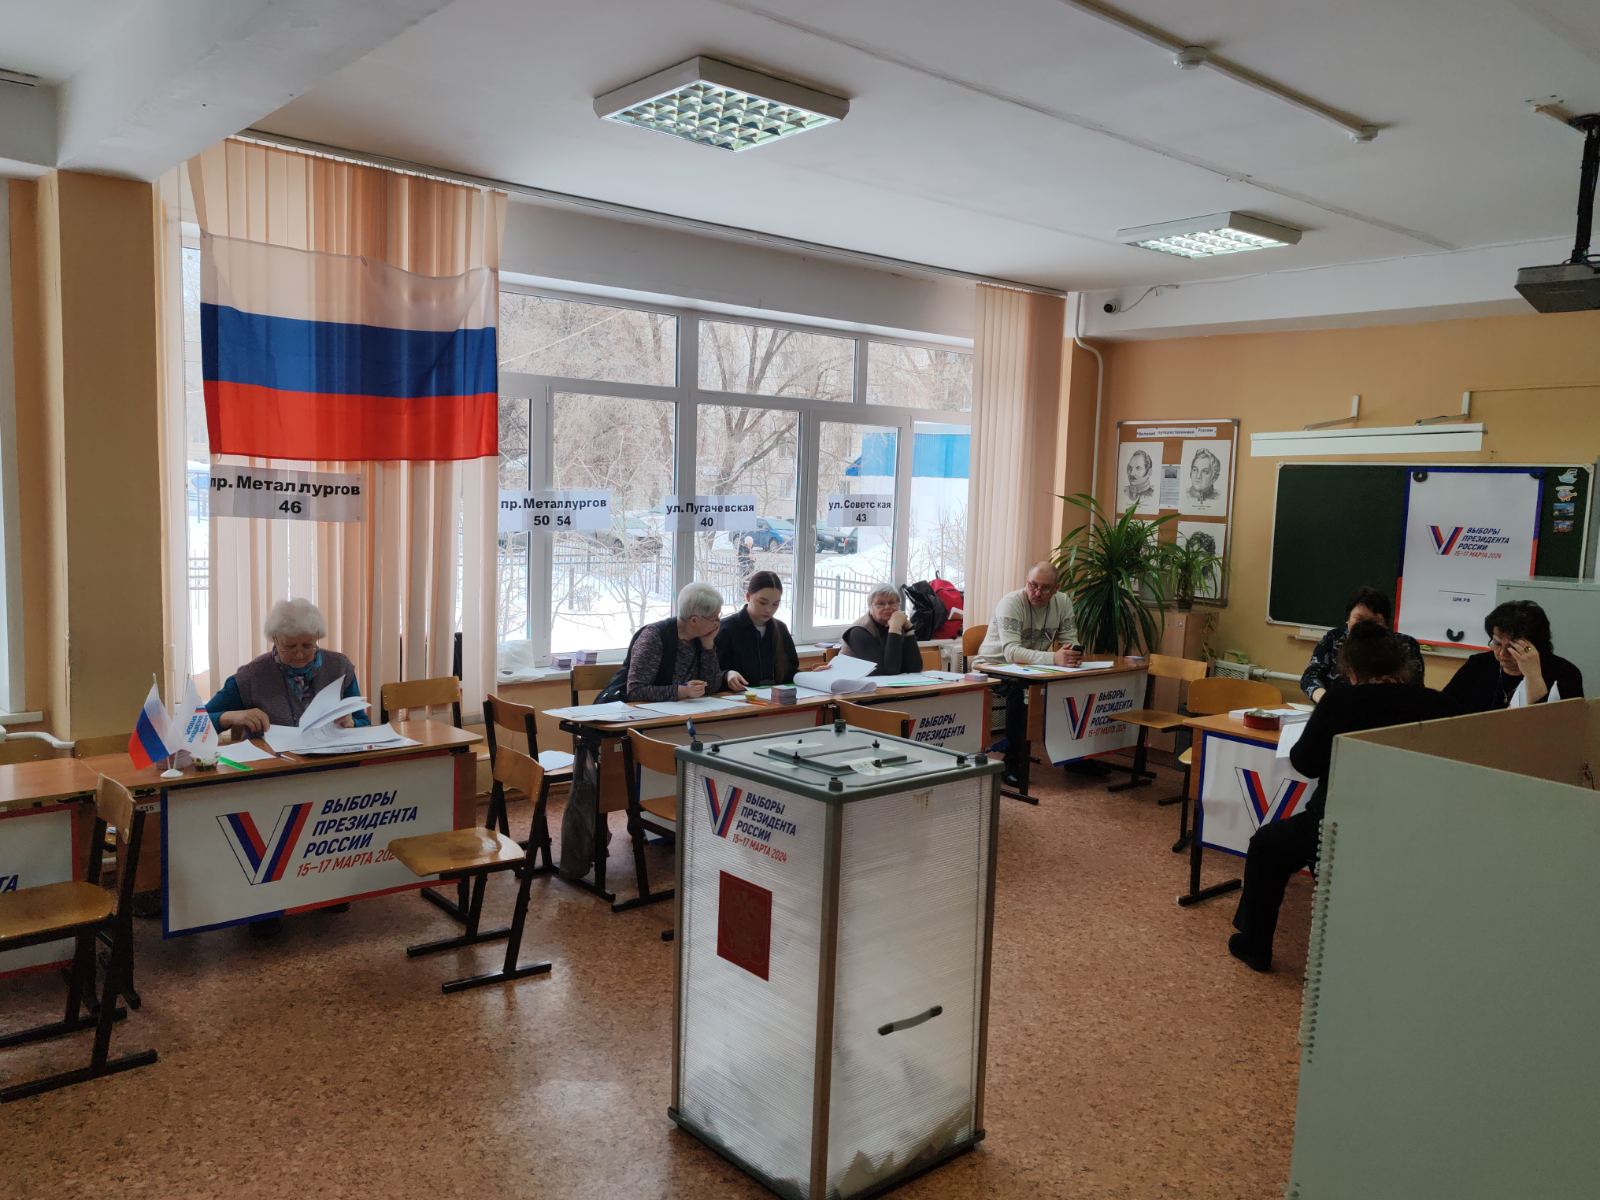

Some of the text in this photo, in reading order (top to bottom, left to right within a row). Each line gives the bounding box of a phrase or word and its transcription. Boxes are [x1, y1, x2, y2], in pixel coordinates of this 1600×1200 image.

[278, 500, 303, 514] 46
[533, 515, 572, 526] 50 54
[700, 517, 714, 527] 40
[856, 513, 867, 522] 43
[1461, 535, 1510, 544] ПРЕЗИДЕНТА
[1466, 527, 1501, 536] ВЫБОРЫ
[1457, 543, 1488, 551] РОССИИ
[1098, 689, 1127, 701] ВЫБОРЫ
[919, 713, 956, 728] ВЫБОРЫ
[915, 725, 966, 742] ПРЕЗИДЕНТА
[321, 790, 398, 815] ВЫБОРЫ
[745, 792, 785, 815] ВЫБОРЫ
[312, 806, 418, 837] ПРЕЗИДЕНТА
[740, 806, 797, 836] ПРЕЗИДЕНТА
[736, 820, 772, 842] РОССИИ
[303, 833, 374, 859] РОССИИ
[749, 839, 771, 858] МАРТА
[771, 848, 788, 863] 2024
[331, 851, 373, 871] МАРТА
